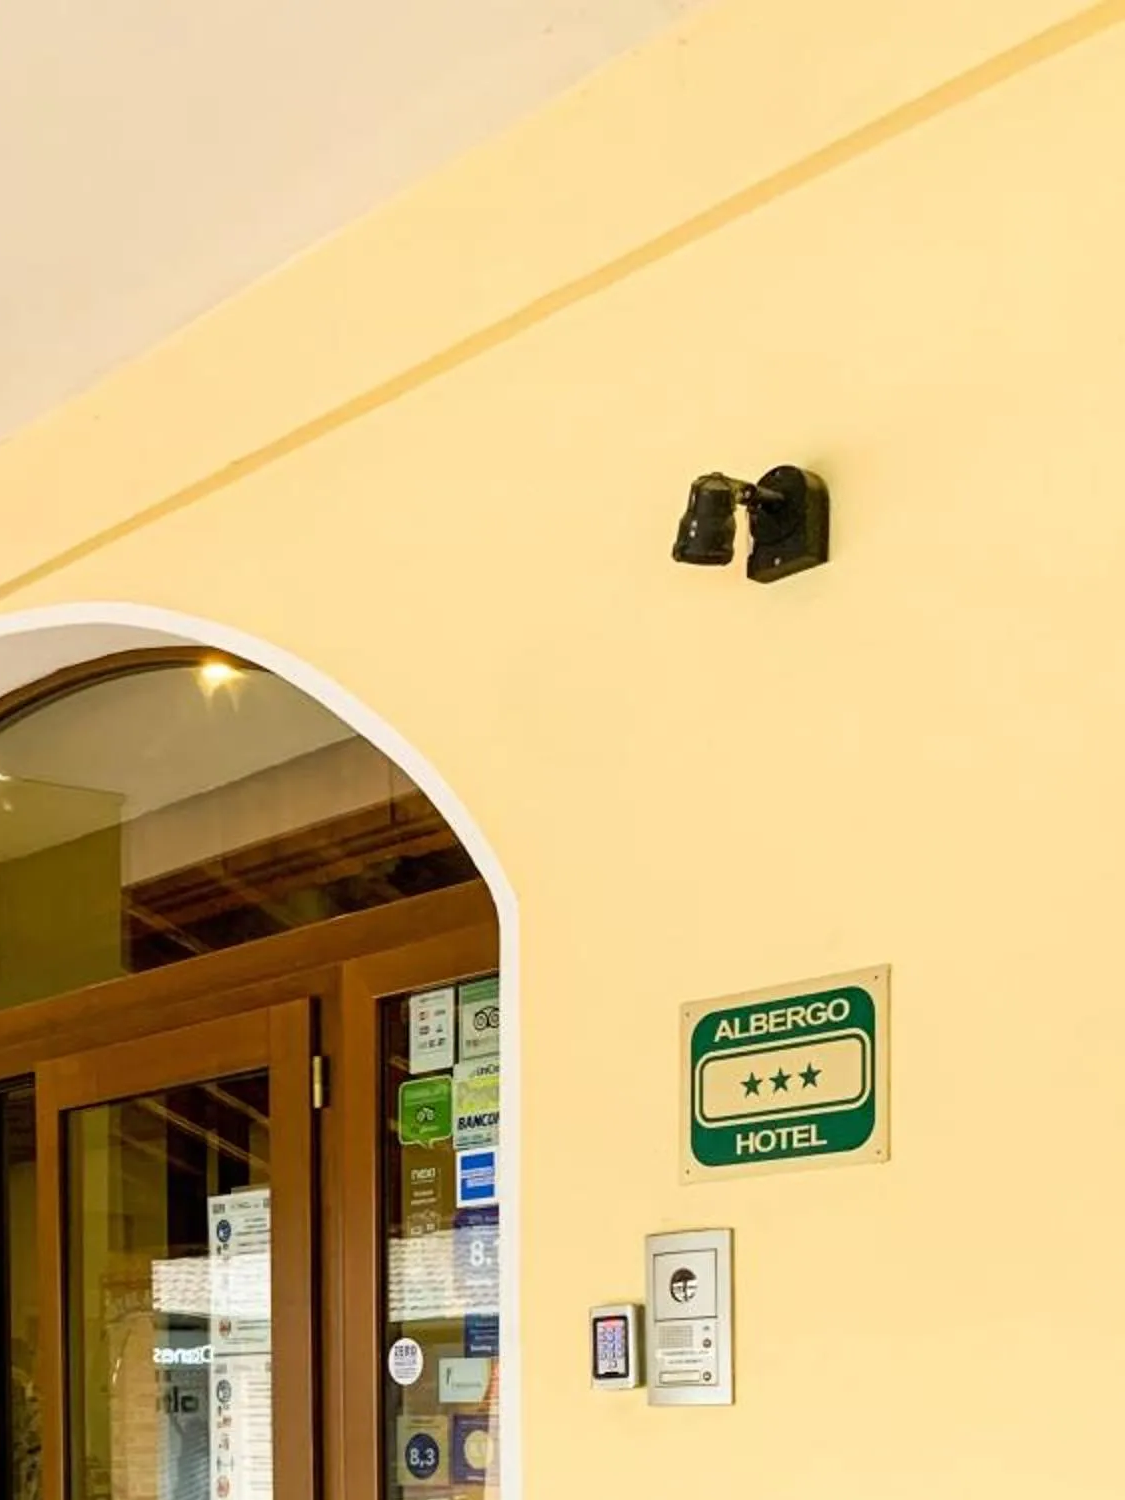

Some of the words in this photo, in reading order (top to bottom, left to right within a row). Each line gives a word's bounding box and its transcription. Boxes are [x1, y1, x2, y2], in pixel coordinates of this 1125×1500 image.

[713, 998, 851, 1042] ALBERGO
[736, 1124, 828, 1156] HOTEL
[410, 1447, 435, 1469] 8,3
